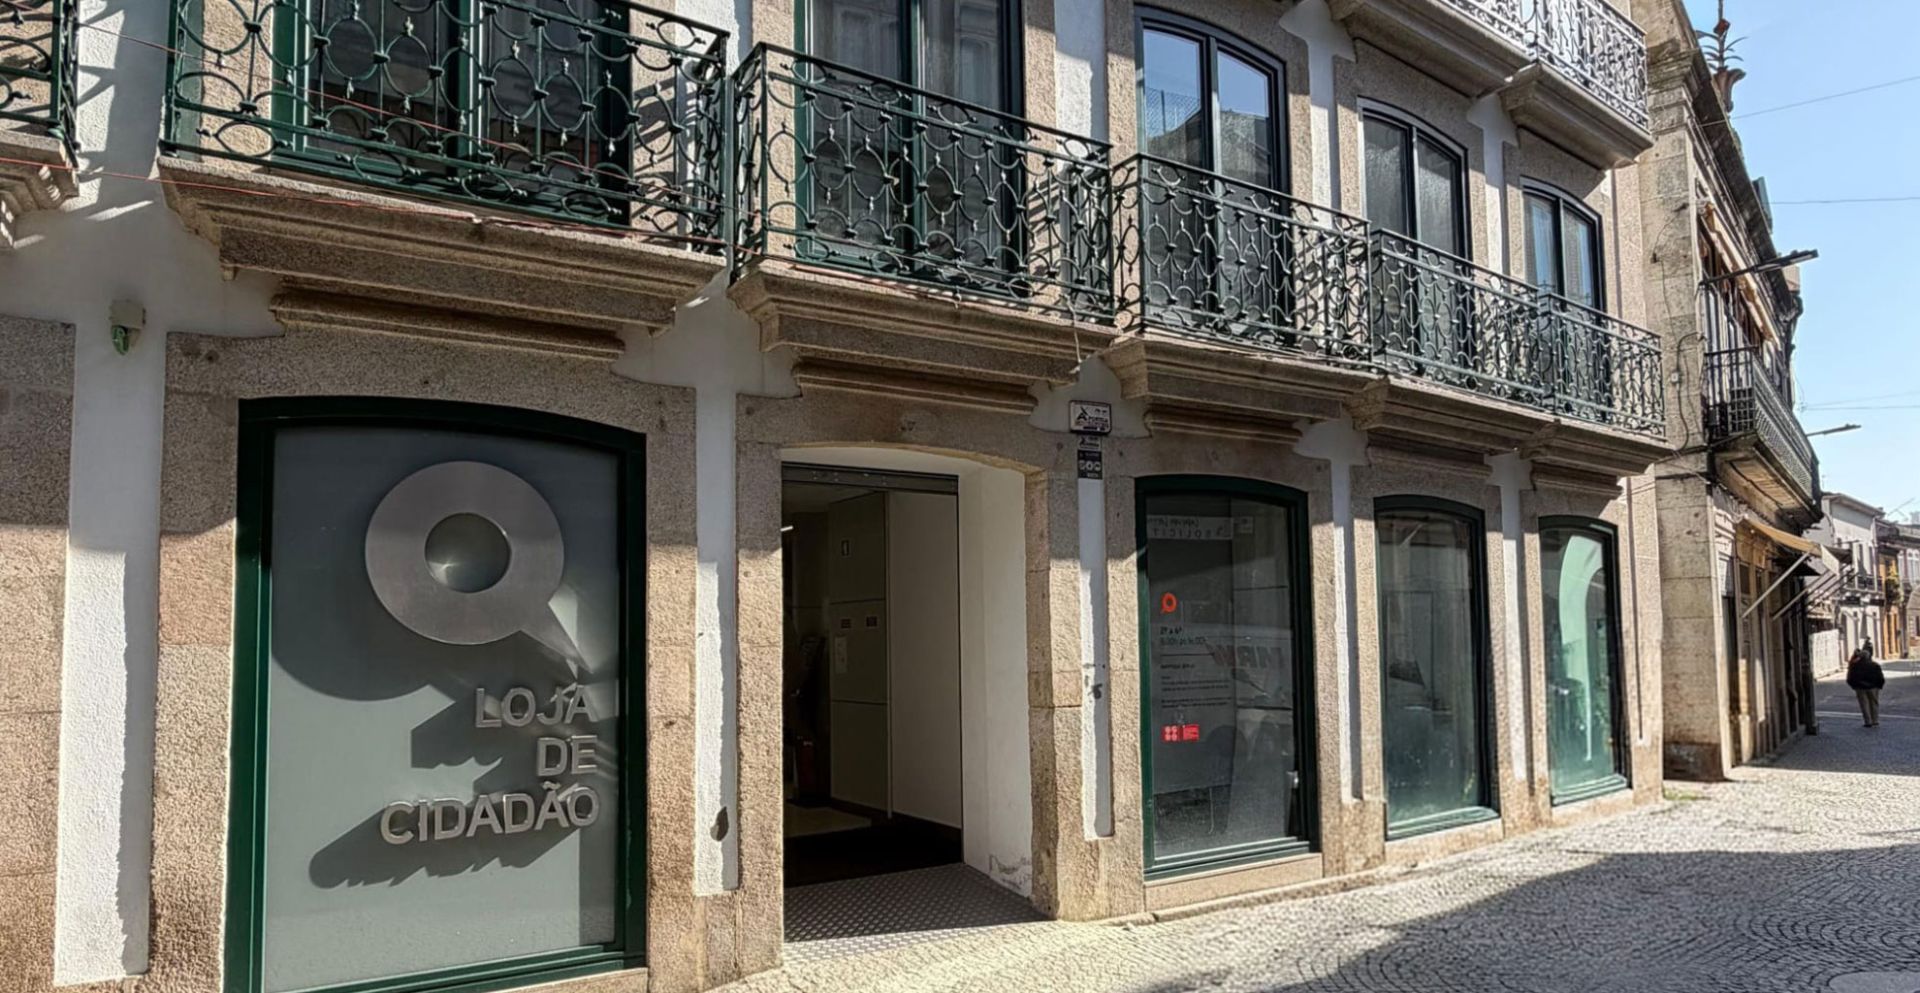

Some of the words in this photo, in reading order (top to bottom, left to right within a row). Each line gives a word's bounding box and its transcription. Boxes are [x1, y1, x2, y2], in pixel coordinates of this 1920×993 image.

[474, 684, 599, 728] LOJA
[537, 734, 598, 777] DE
[380, 781, 600, 845] CIDADÃO
